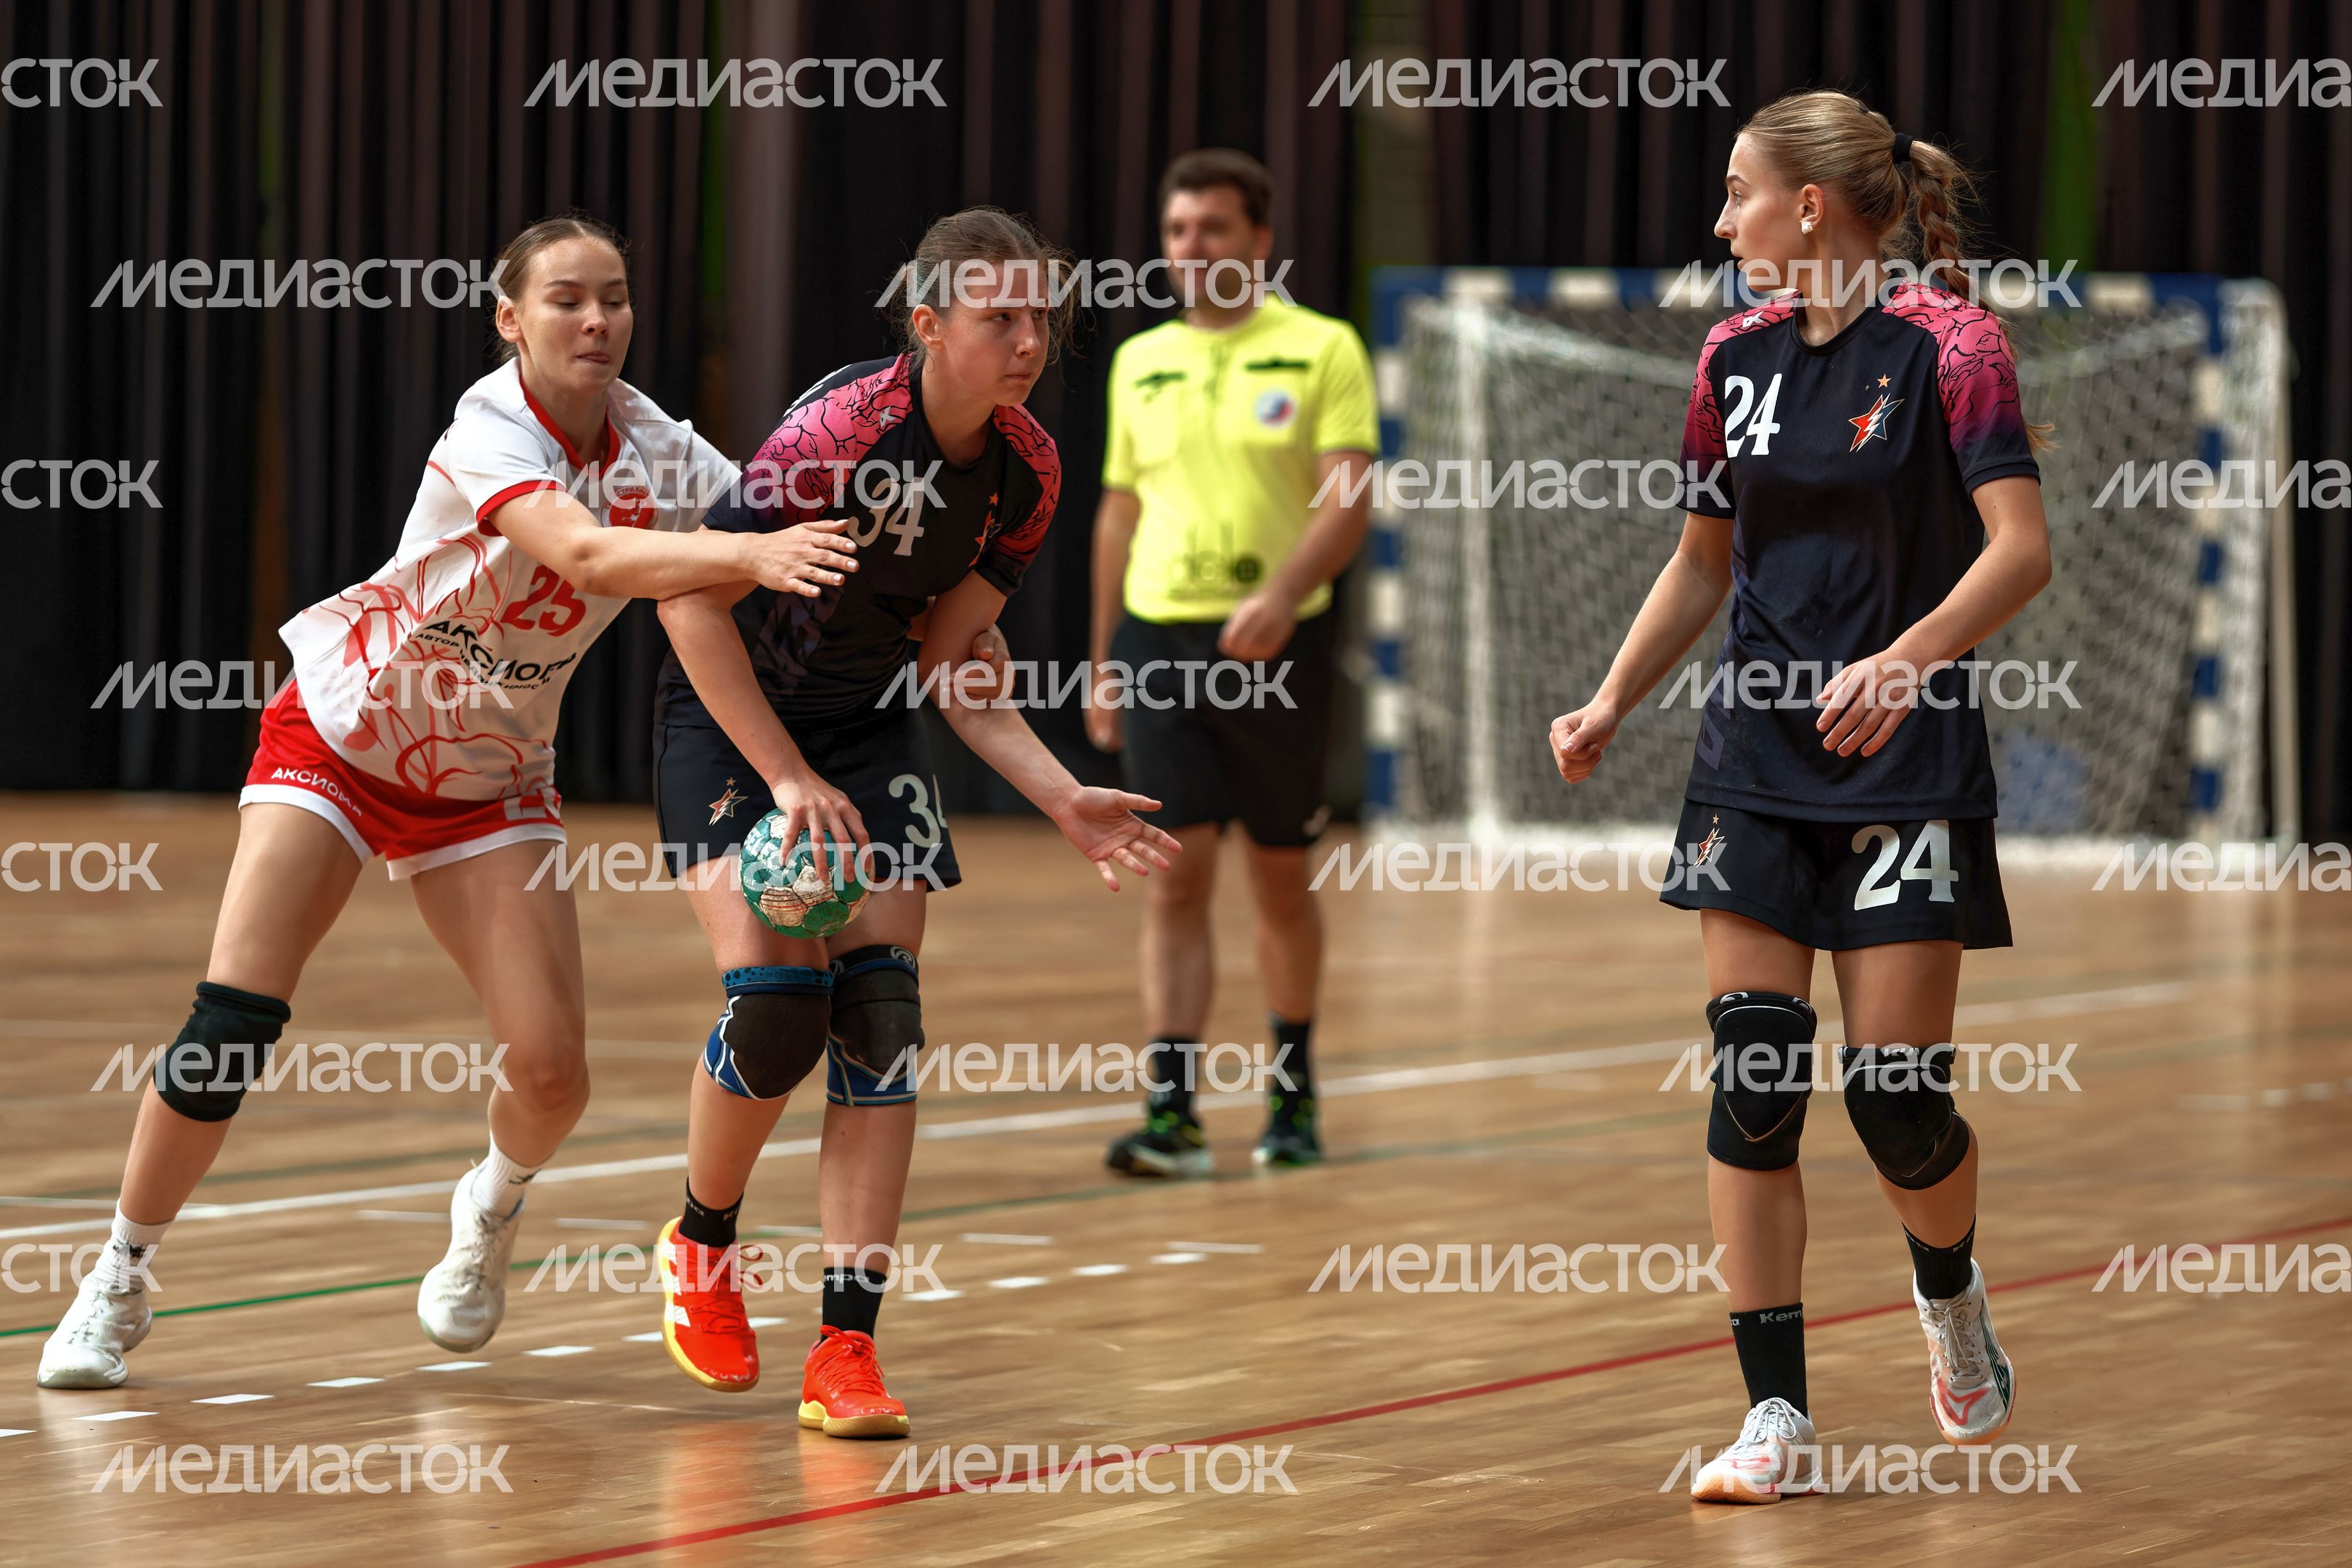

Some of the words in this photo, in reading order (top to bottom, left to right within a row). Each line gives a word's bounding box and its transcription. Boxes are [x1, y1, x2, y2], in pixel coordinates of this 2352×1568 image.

[1725, 373, 1782, 458] 24
[847, 476, 925, 557] 34
[500, 565, 587, 637] 25
[889, 774, 948, 848] 3
[1852, 820, 1959, 910] 24
[824, 1274, 870, 1284] mpa
[1760, 1310, 1803, 1324] Kem
